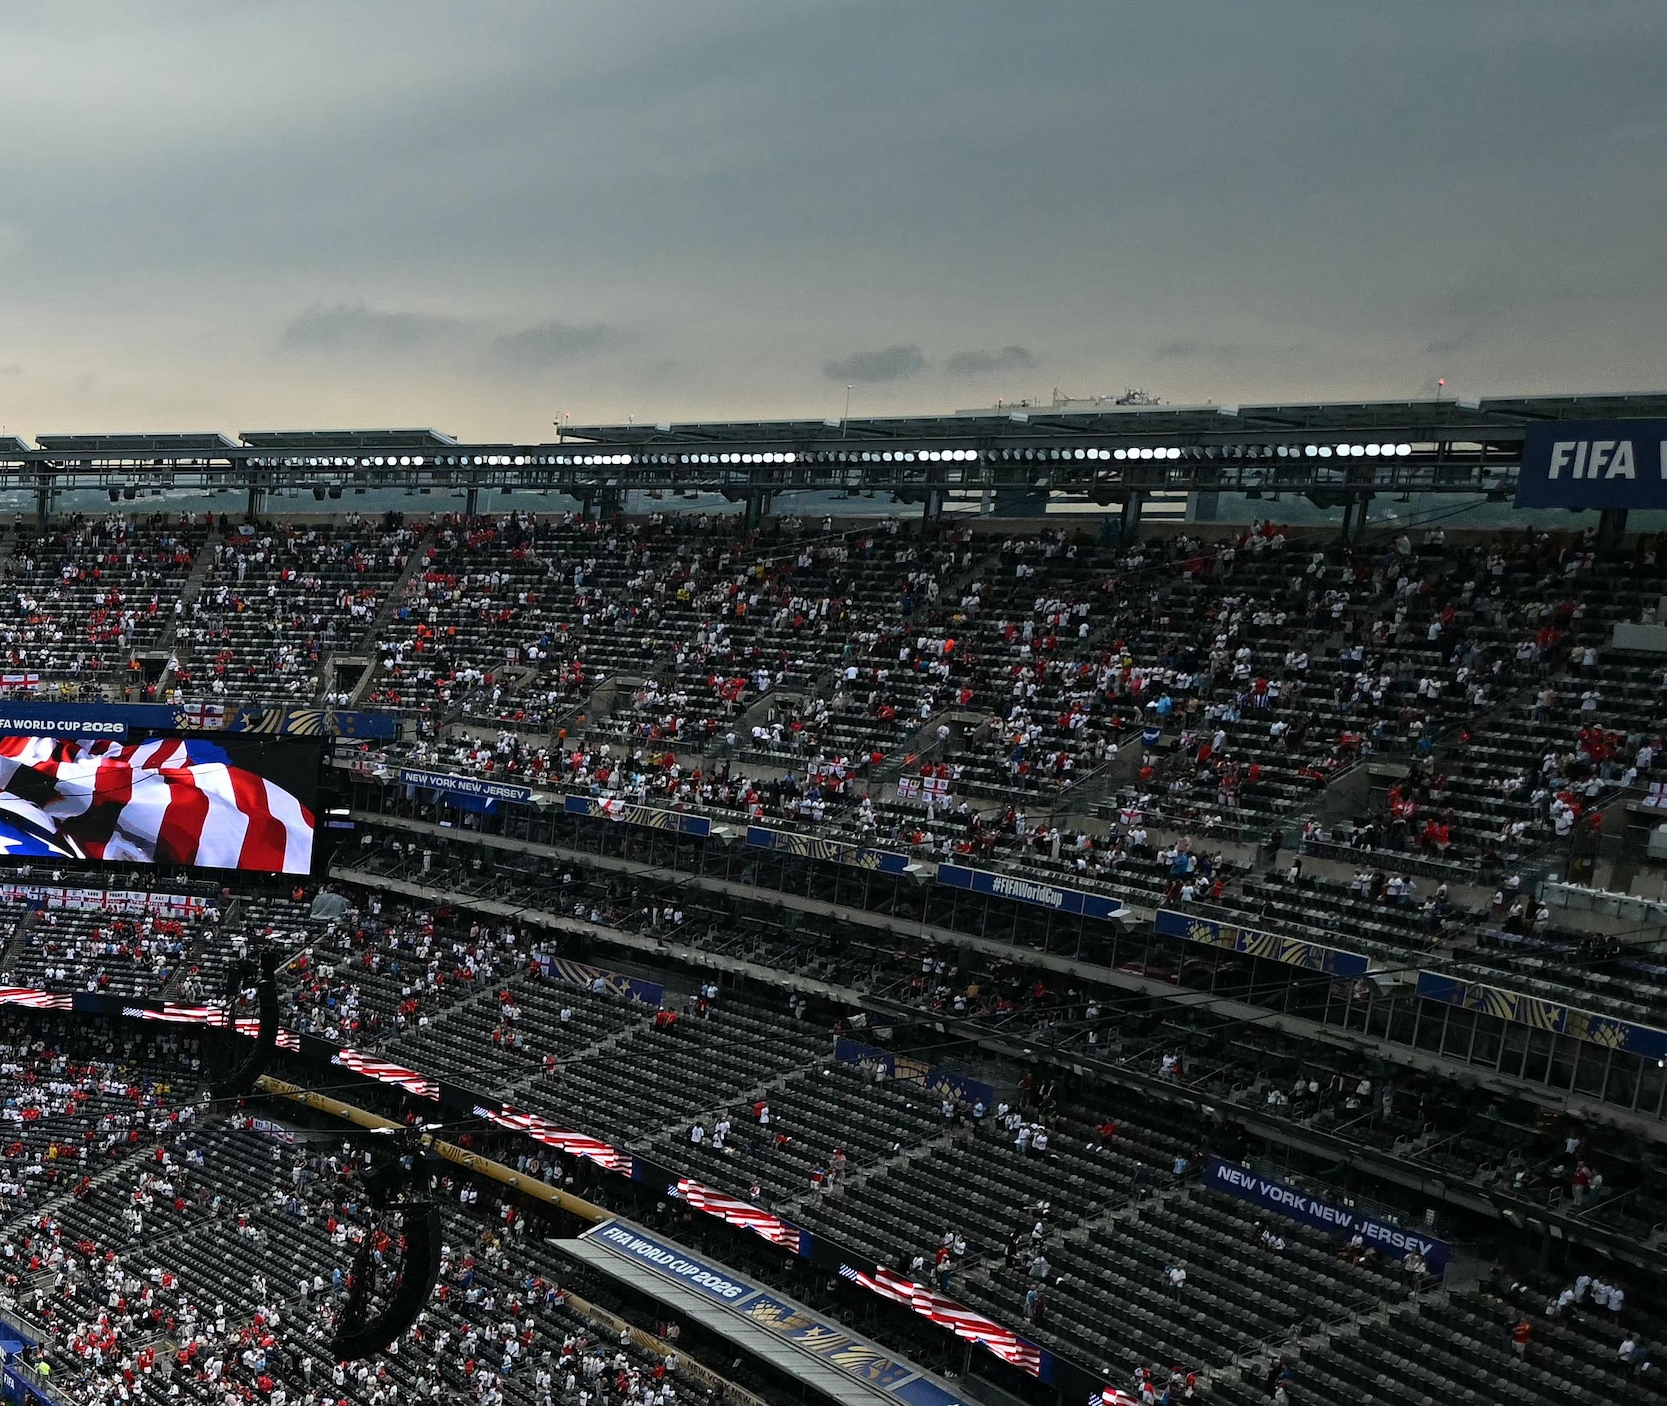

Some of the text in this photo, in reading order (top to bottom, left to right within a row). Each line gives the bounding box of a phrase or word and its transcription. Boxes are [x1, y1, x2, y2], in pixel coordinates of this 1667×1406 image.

[1547, 440, 1636, 480] FIFA
[13, 719, 56, 730] WORLD
[57, 720, 81, 731] CUP
[82, 721, 124, 733] 2026
[405, 772, 525, 800] NEW YORK NEW JERSEY
[992, 877, 1064, 908] #FIFAWorldCup
[1217, 1165, 1434, 1256] NEW YORK NEW JERSEY
[602, 1226, 743, 1299] FIFA WORLD CUP 2026
[3, 1372, 15, 1391] FIFA
[686, 1361, 707, 1377] NEW
[731, 1384, 752, 1404] NEW
